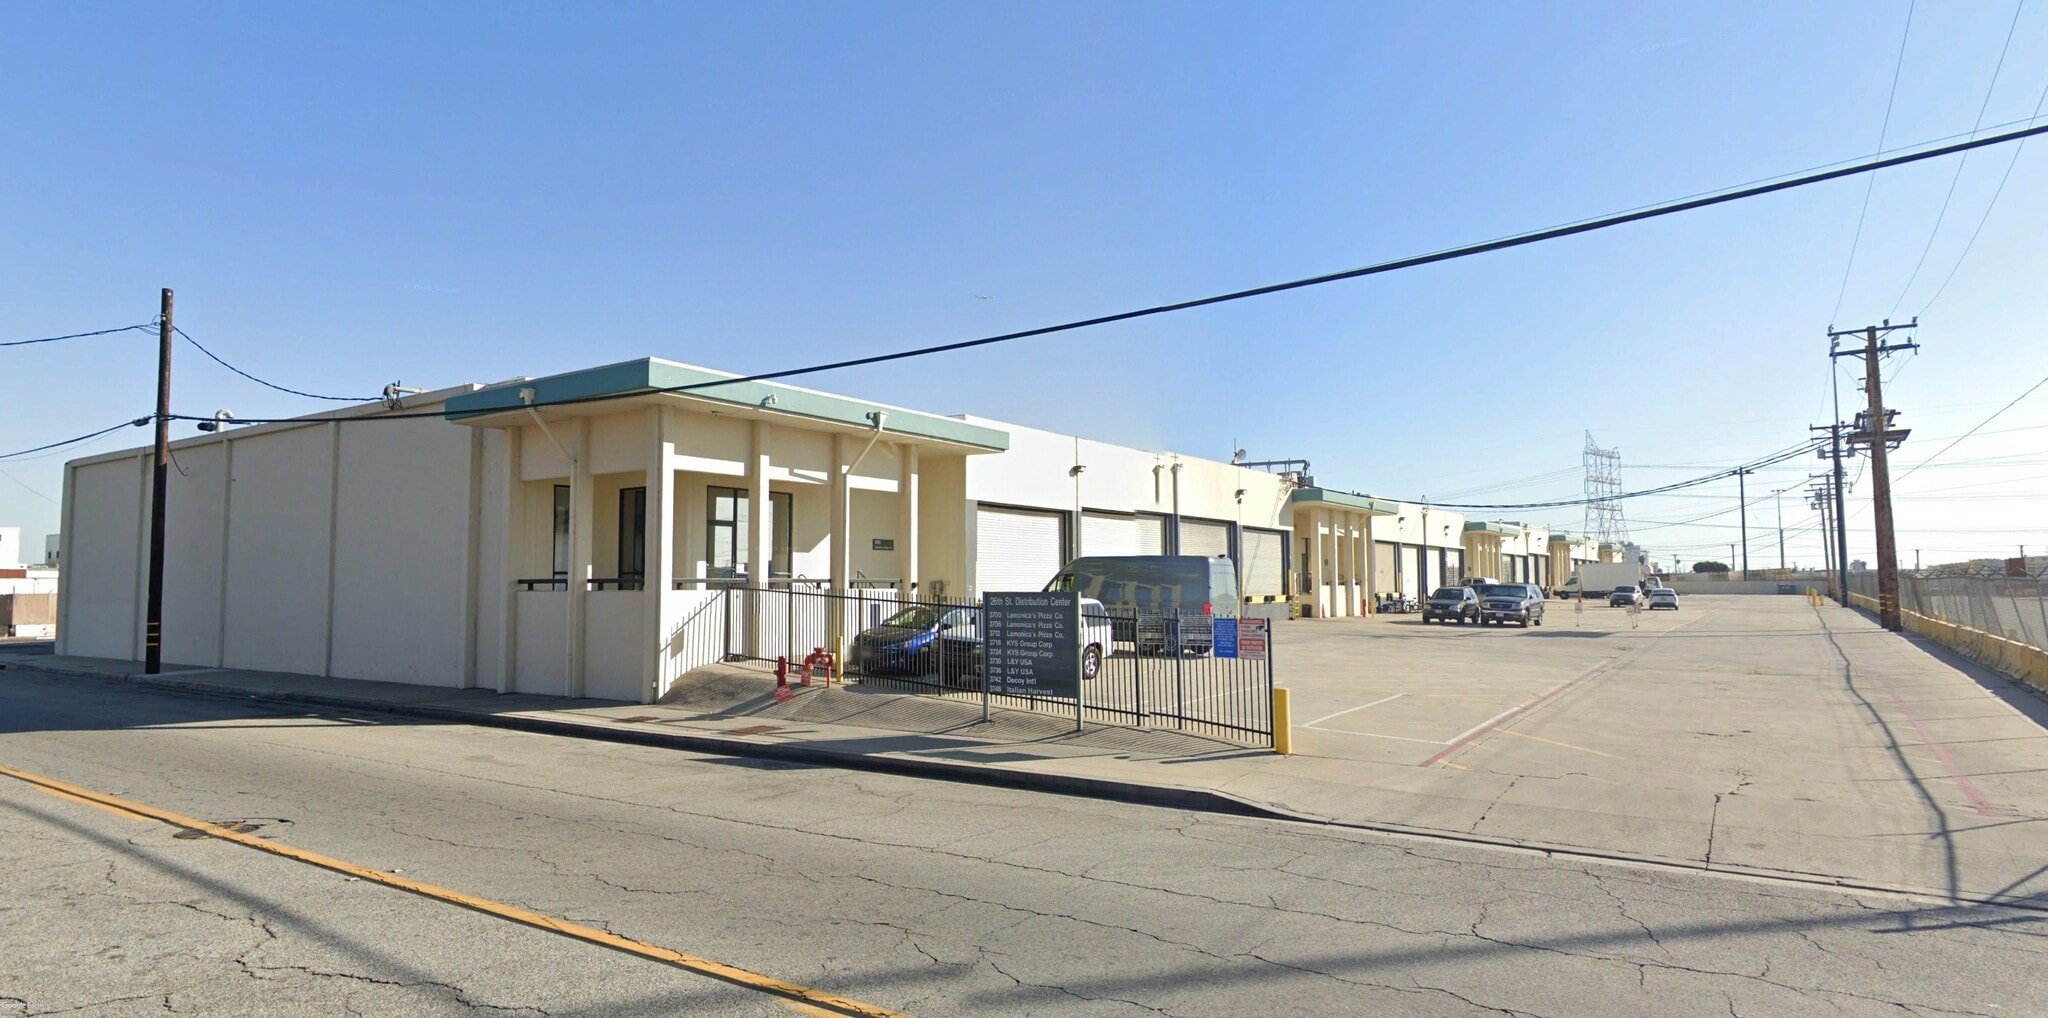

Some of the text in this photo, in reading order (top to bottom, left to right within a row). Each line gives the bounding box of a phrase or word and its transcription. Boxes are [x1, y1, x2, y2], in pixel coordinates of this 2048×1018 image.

[990, 597, 1071, 606] 26th St. Distribution Center
[1007, 677, 1024, 685] Decoy
[1028, 687, 1054, 695] Harvest
